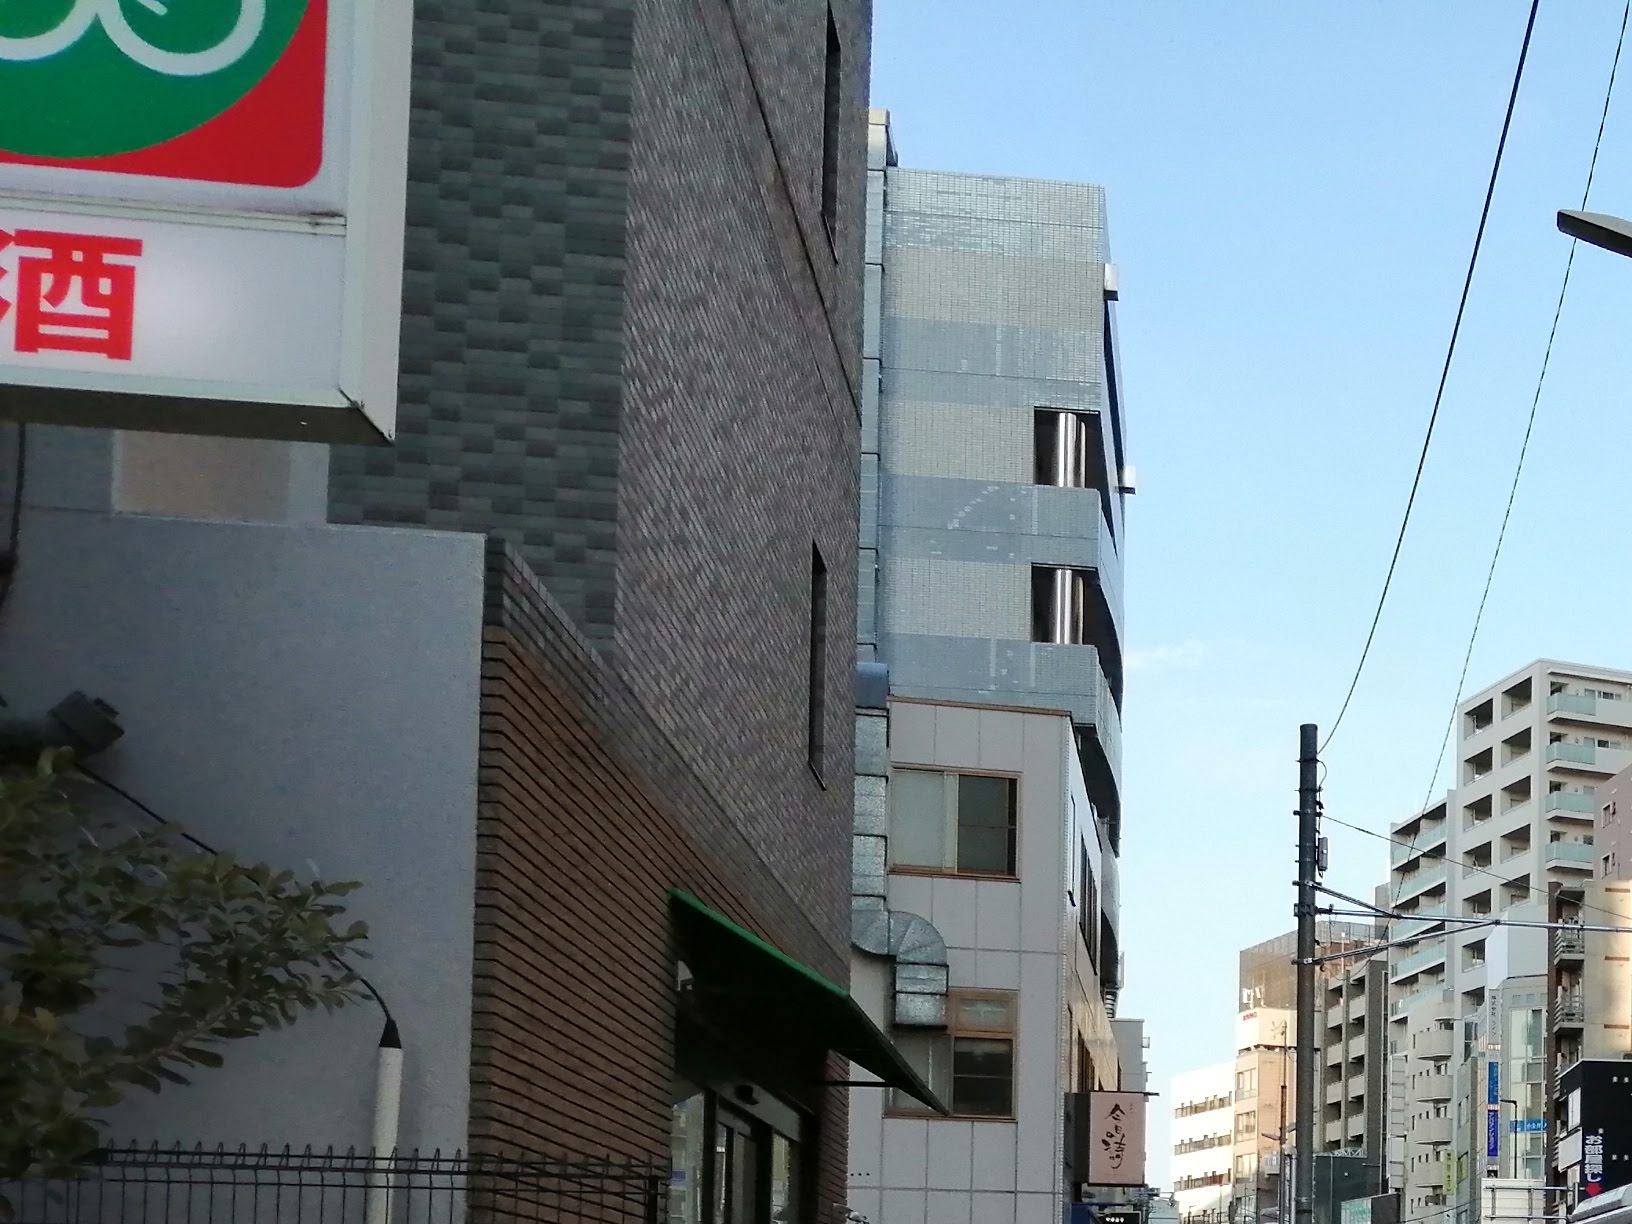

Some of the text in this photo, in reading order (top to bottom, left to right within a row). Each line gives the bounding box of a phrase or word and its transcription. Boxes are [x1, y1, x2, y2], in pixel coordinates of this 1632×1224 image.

[0, 229, 143, 361] 酒
[1584, 1135, 1604, 1183] お部屋探し
